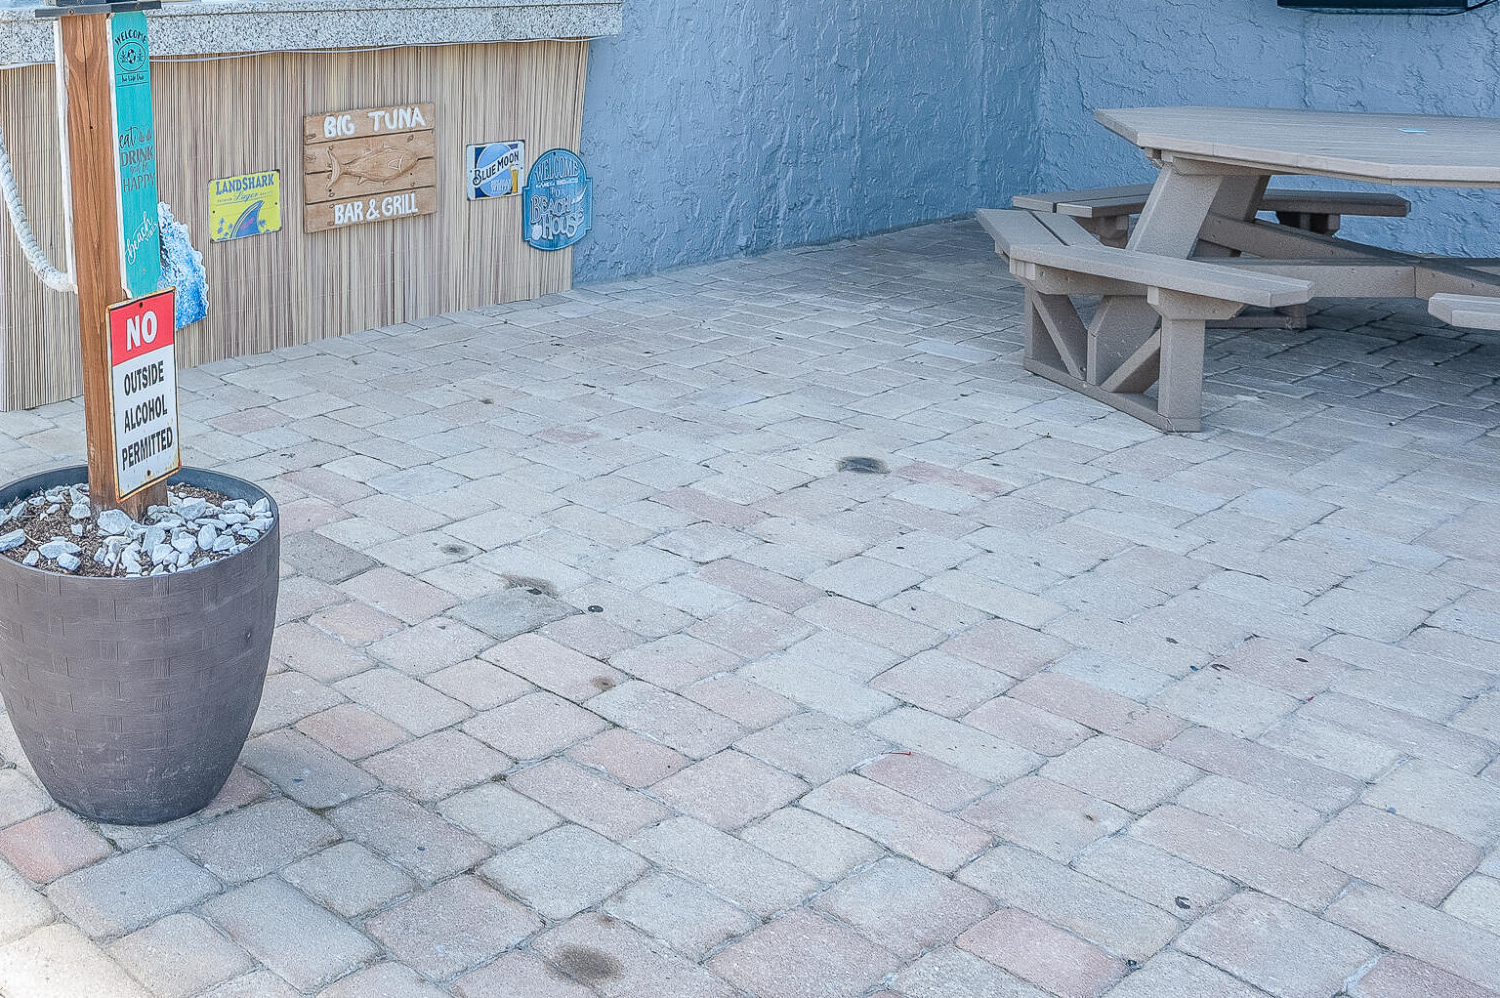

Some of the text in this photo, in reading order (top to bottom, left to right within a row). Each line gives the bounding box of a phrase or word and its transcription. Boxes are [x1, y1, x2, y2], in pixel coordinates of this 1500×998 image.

[115, 28, 147, 47] WELCOME
[324, 106, 426, 138] BIG TUNA
[119, 126, 139, 149] eat
[121, 146, 154, 167] DRINK
[473, 150, 520, 186] BLUE MOON
[534, 155, 579, 184] WELCOME
[123, 172, 155, 193] HAPPY
[216, 173, 275, 196] LANDSHARK
[234, 191, 258, 203] Lager
[334, 192, 419, 225] BAR & GRILL
[530, 195, 572, 224] BEACH
[541, 206, 585, 240] HOUSE
[126, 310, 158, 352] NO
[124, 360, 164, 397] OUTSIDE
[124, 394, 168, 434] ALCOHOL
[122, 426, 173, 472] PERMITTED
